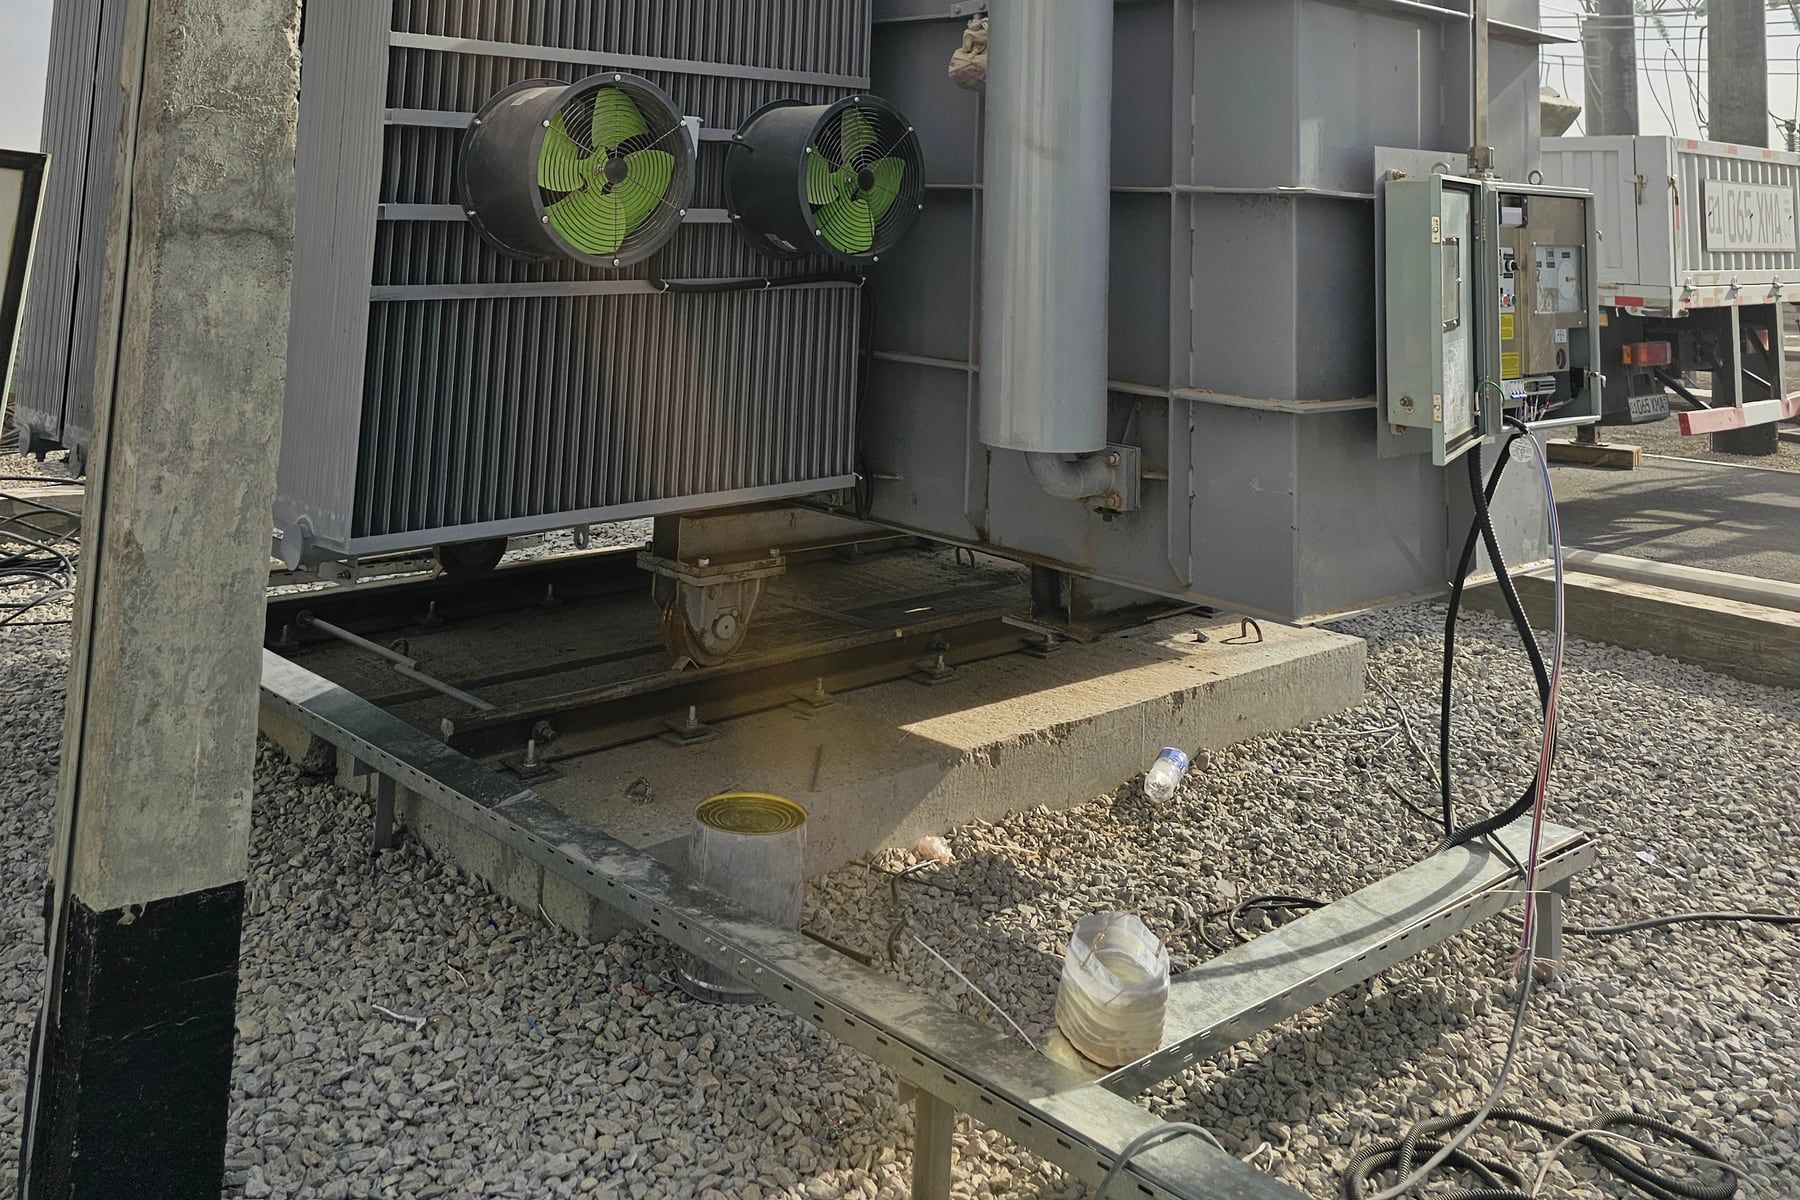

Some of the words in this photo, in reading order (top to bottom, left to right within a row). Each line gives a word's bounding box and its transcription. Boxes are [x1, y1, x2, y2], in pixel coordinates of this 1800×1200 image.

[1708, 195, 1722, 234] 01
[1727, 189, 1752, 243] 065
[1756, 191, 1782, 244] XMA
[1637, 398, 1651, 415] 065
